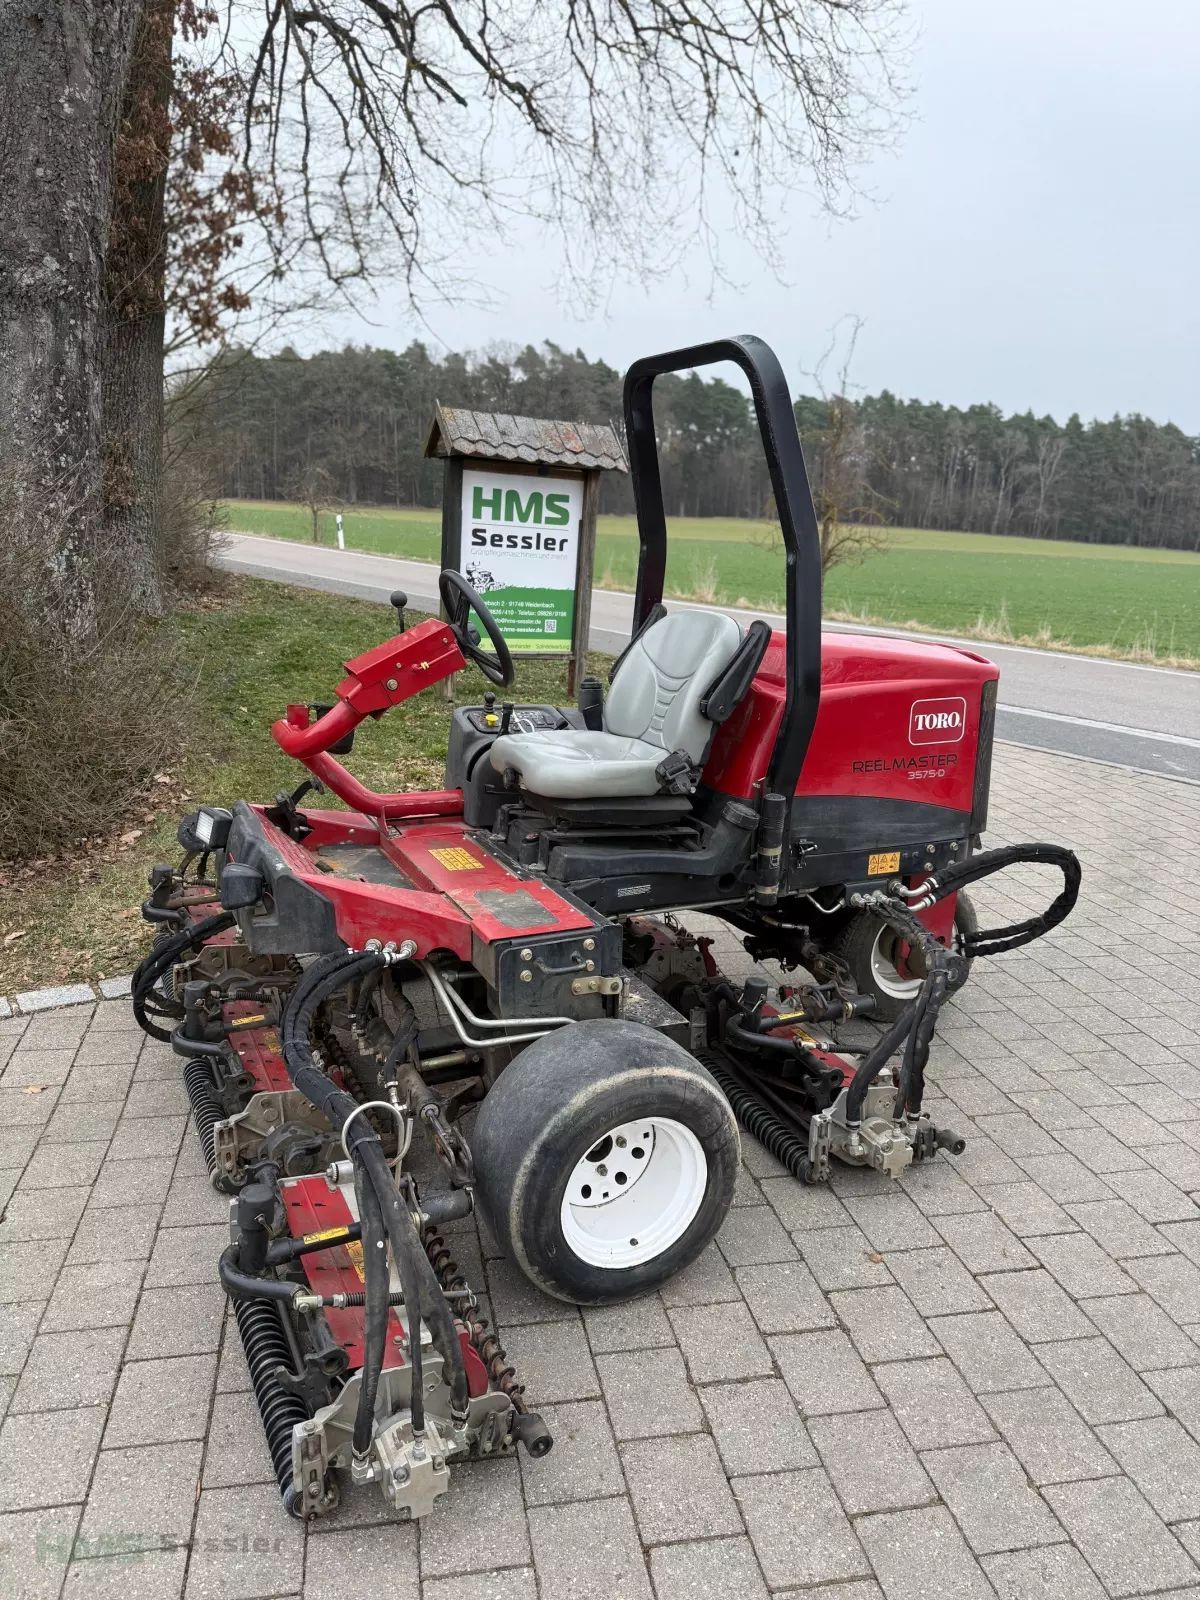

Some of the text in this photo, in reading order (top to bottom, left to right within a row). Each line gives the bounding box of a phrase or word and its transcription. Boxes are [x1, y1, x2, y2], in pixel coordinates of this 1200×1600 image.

[472, 486, 570, 525] HMS
[471, 528, 569, 551] Sessler
[914, 711, 963, 729] TORO
[852, 753, 958, 773] REELMASTER
